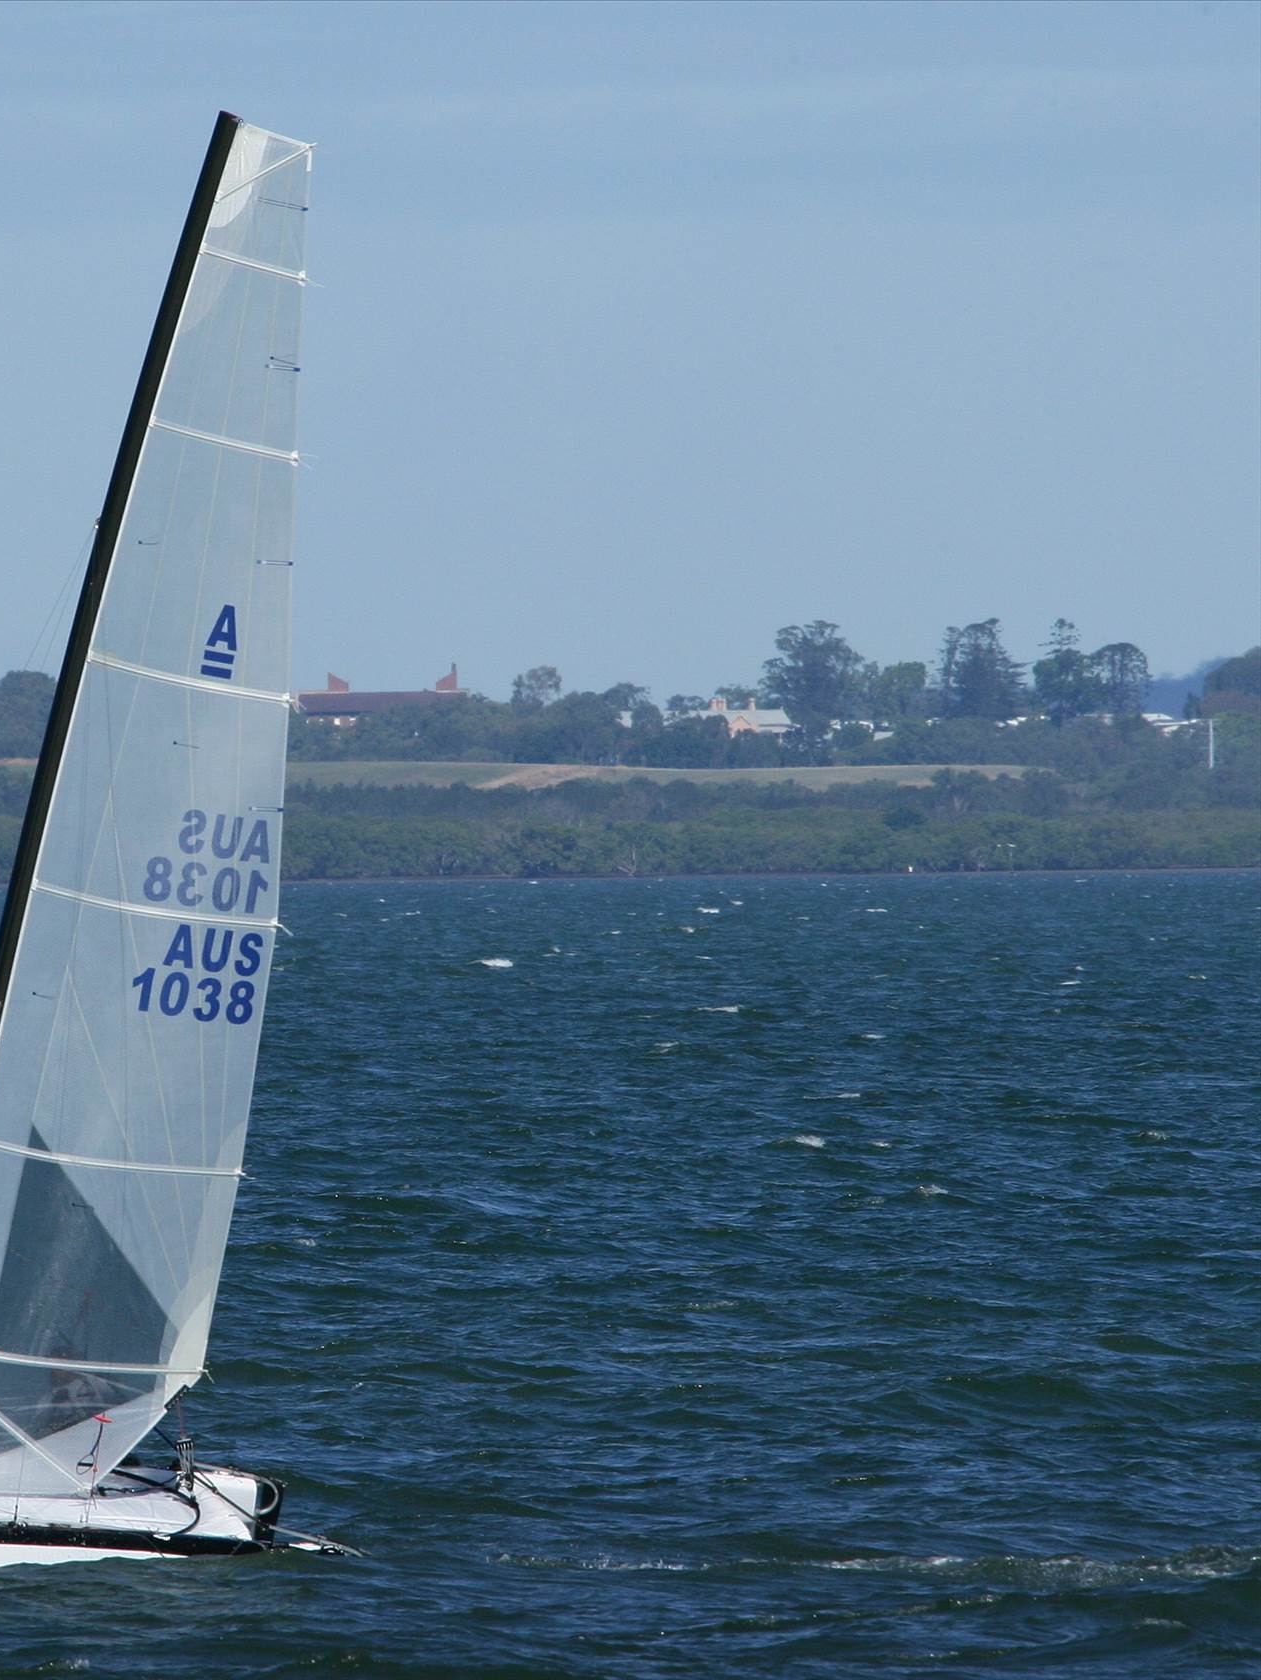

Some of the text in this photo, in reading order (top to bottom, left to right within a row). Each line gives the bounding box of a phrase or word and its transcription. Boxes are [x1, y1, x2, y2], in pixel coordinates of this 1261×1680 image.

[207, 604, 238, 651] A
[163, 924, 264, 977] AUS
[131, 967, 256, 1025] 1038
